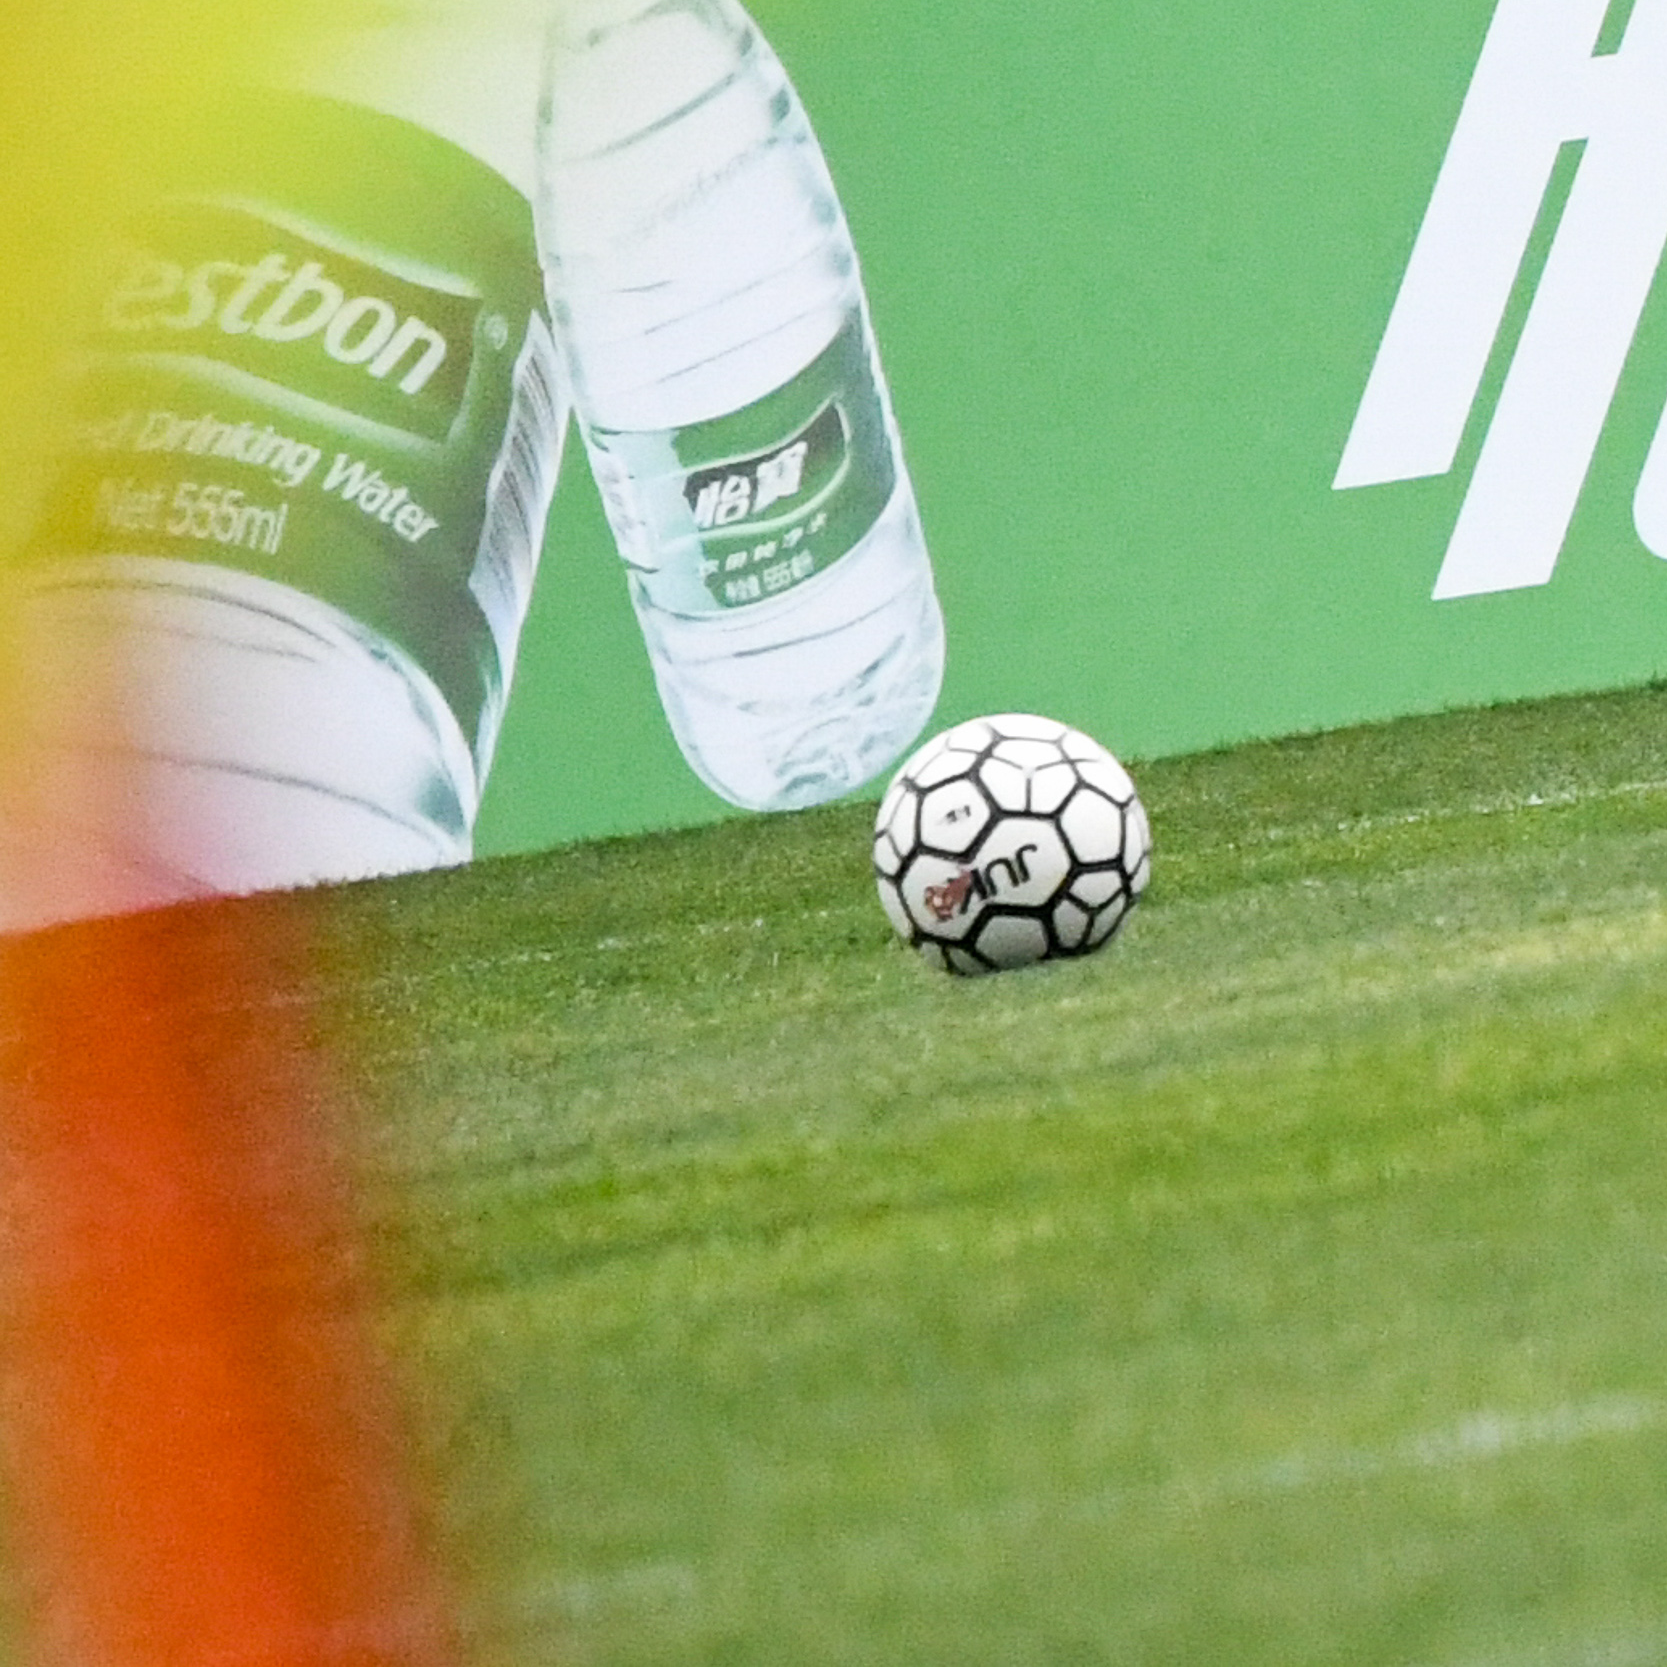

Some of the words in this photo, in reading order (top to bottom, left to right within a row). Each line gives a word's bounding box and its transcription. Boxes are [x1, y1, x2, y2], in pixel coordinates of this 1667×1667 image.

[103, 251, 448, 396] estbon
[135, 410, 321, 488] Drinking
[322, 452, 440, 544] Water
